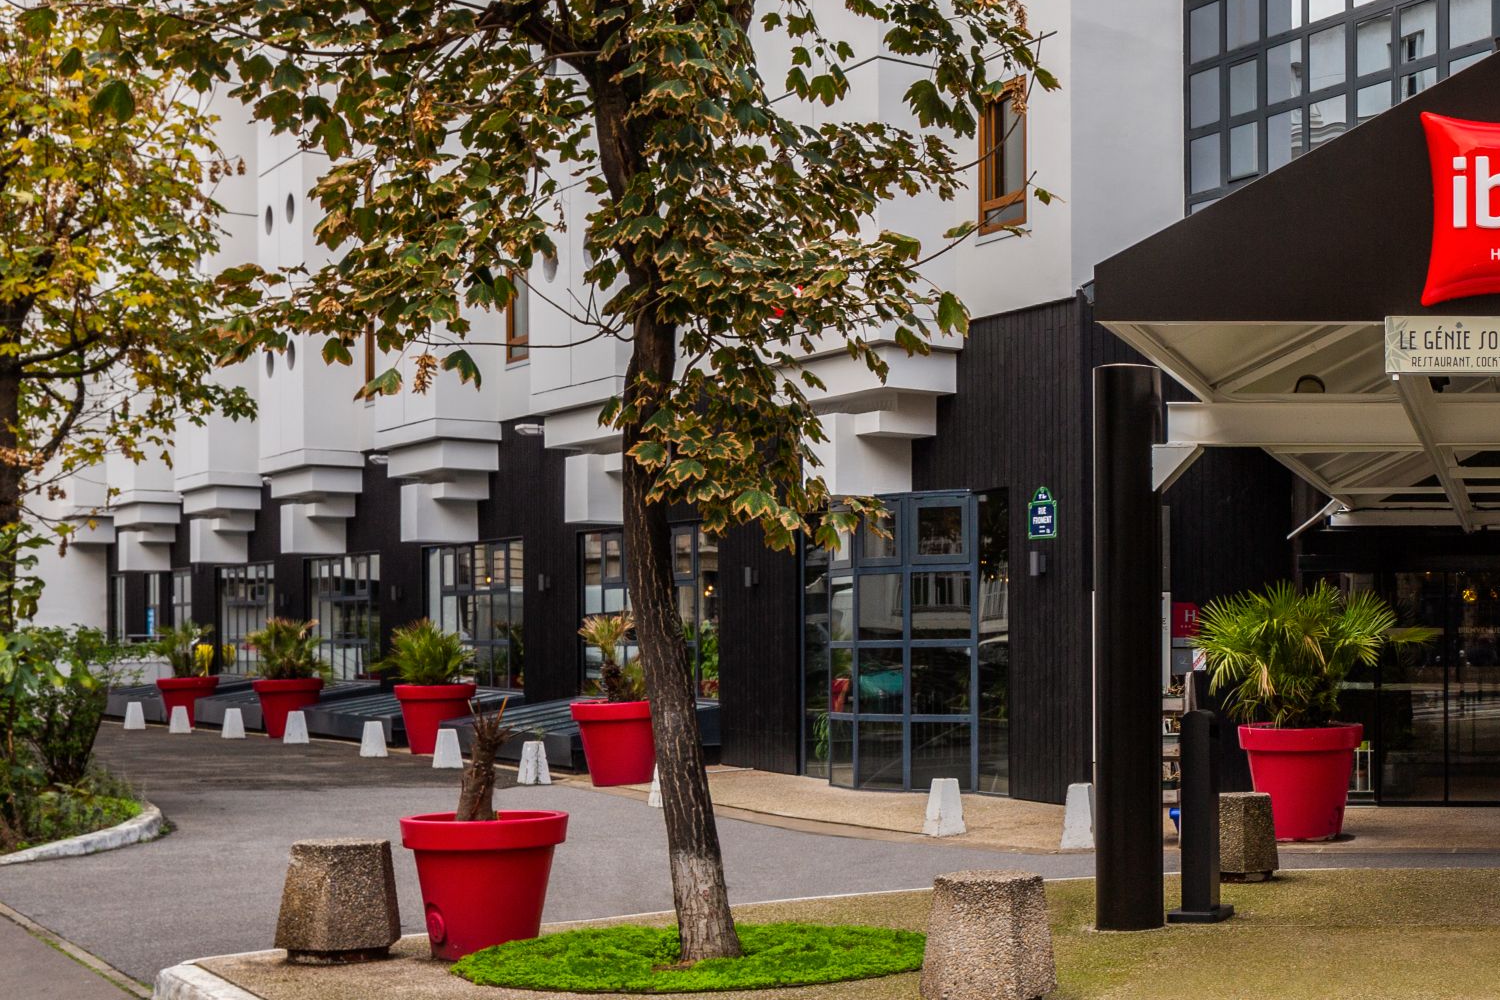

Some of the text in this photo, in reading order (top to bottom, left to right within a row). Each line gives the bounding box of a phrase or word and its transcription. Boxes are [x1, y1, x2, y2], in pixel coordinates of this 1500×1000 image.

[1399, 330, 1417, 350] LE
[1424, 325, 1471, 350] GÉNIE
[1411, 356, 1474, 368] RESTAURANT,
[1038, 506, 1047, 515] RUE
[1184, 609, 1196, 623] H
